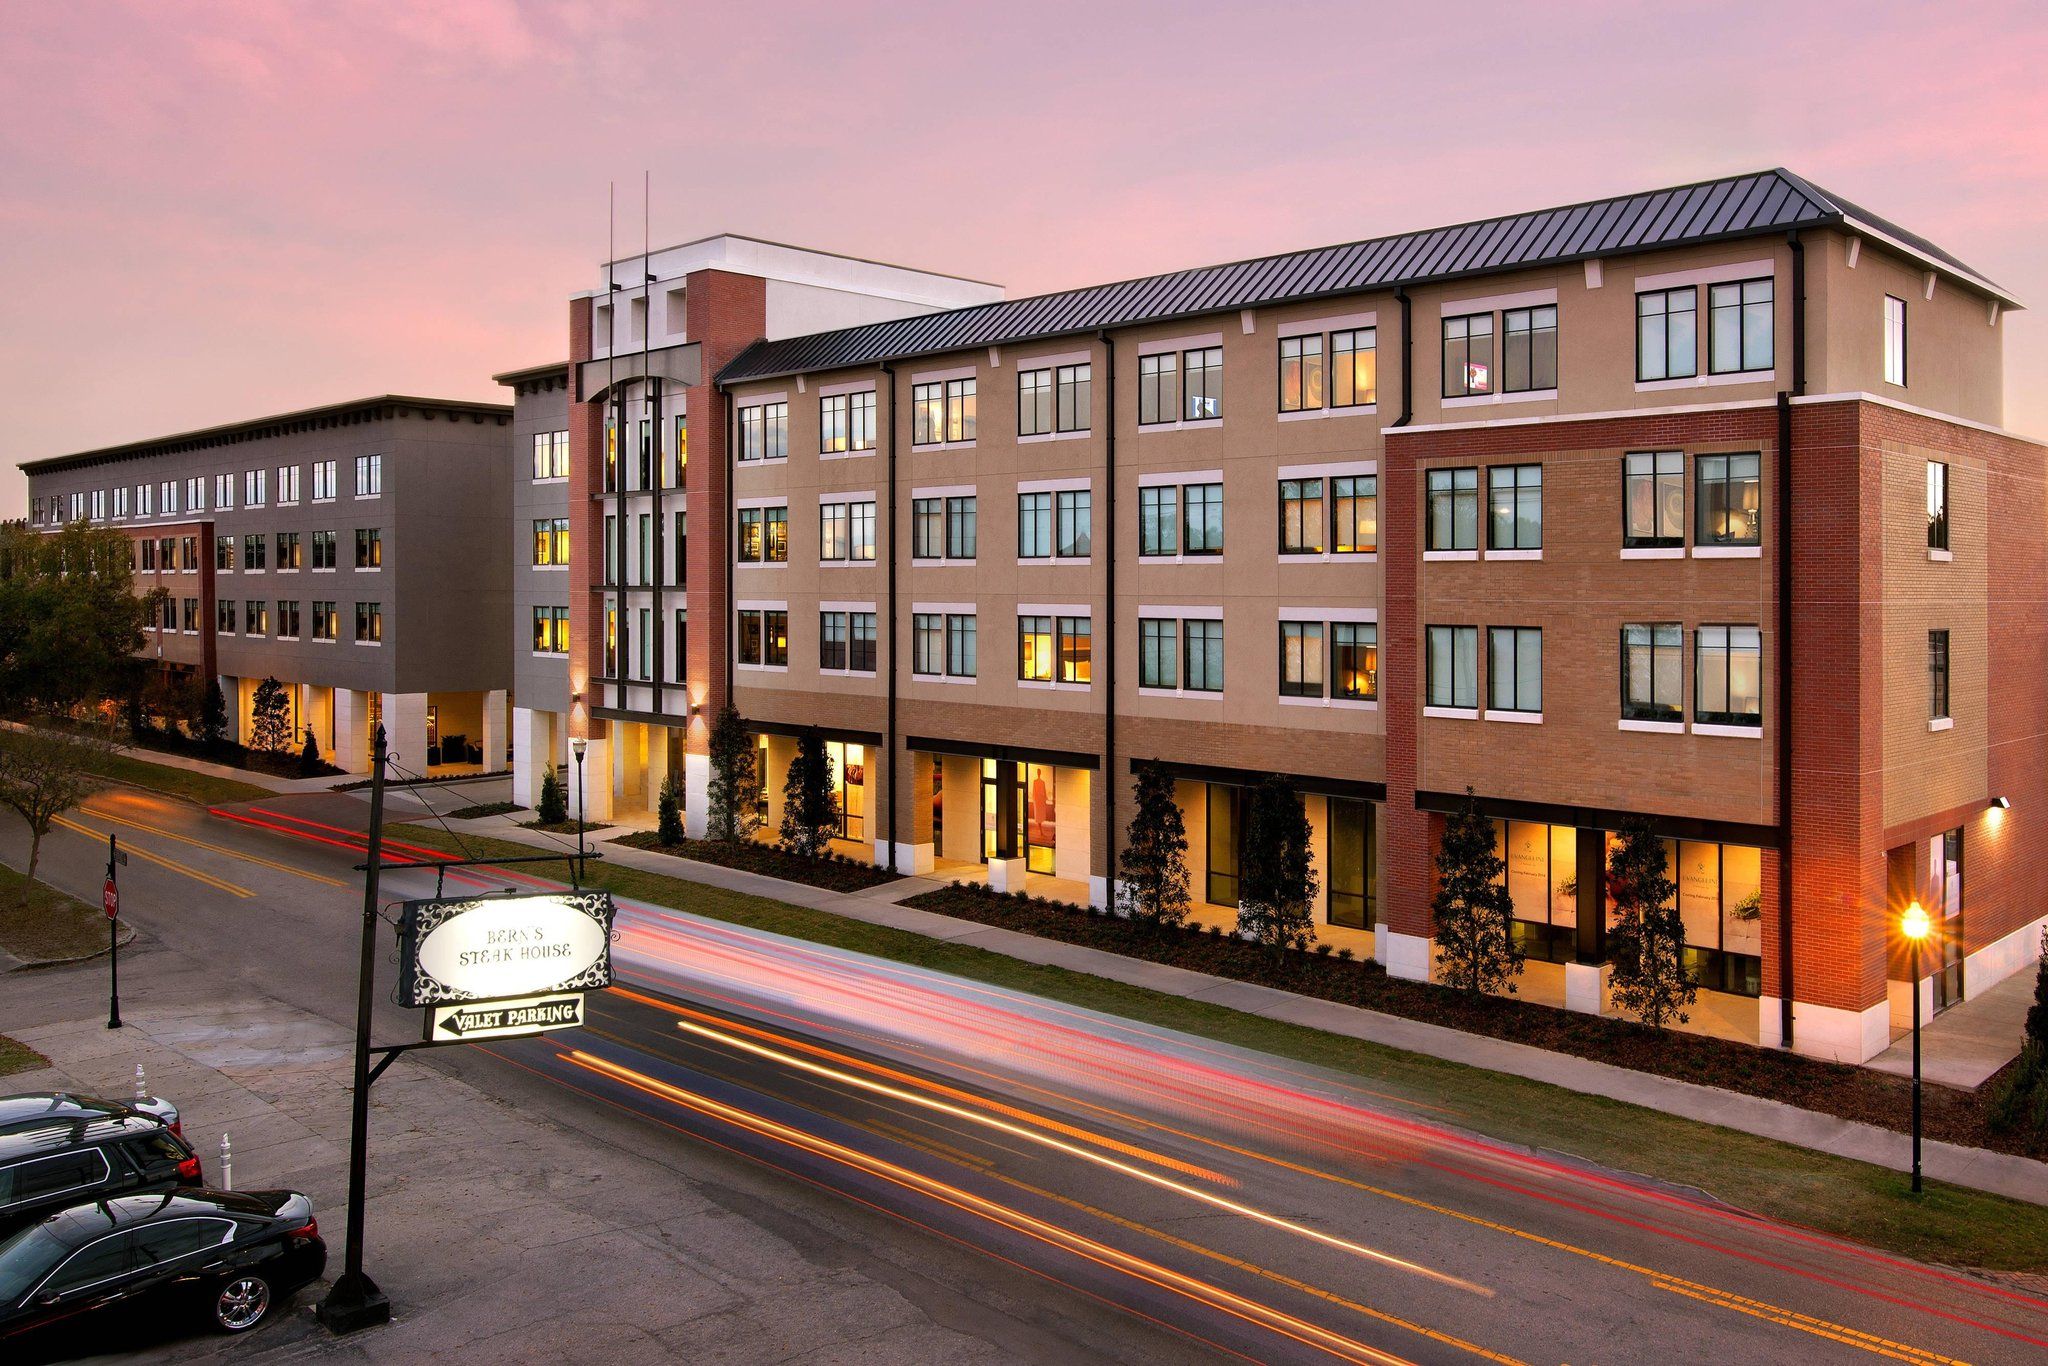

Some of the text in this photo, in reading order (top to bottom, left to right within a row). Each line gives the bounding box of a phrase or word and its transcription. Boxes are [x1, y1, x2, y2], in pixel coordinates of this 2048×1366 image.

[105, 890, 116, 906] STOP
[488, 926, 543, 944] BERN'S
[459, 943, 571, 966] STEAK HOUSE
[452, 1004, 574, 1031] VALET PARKING
